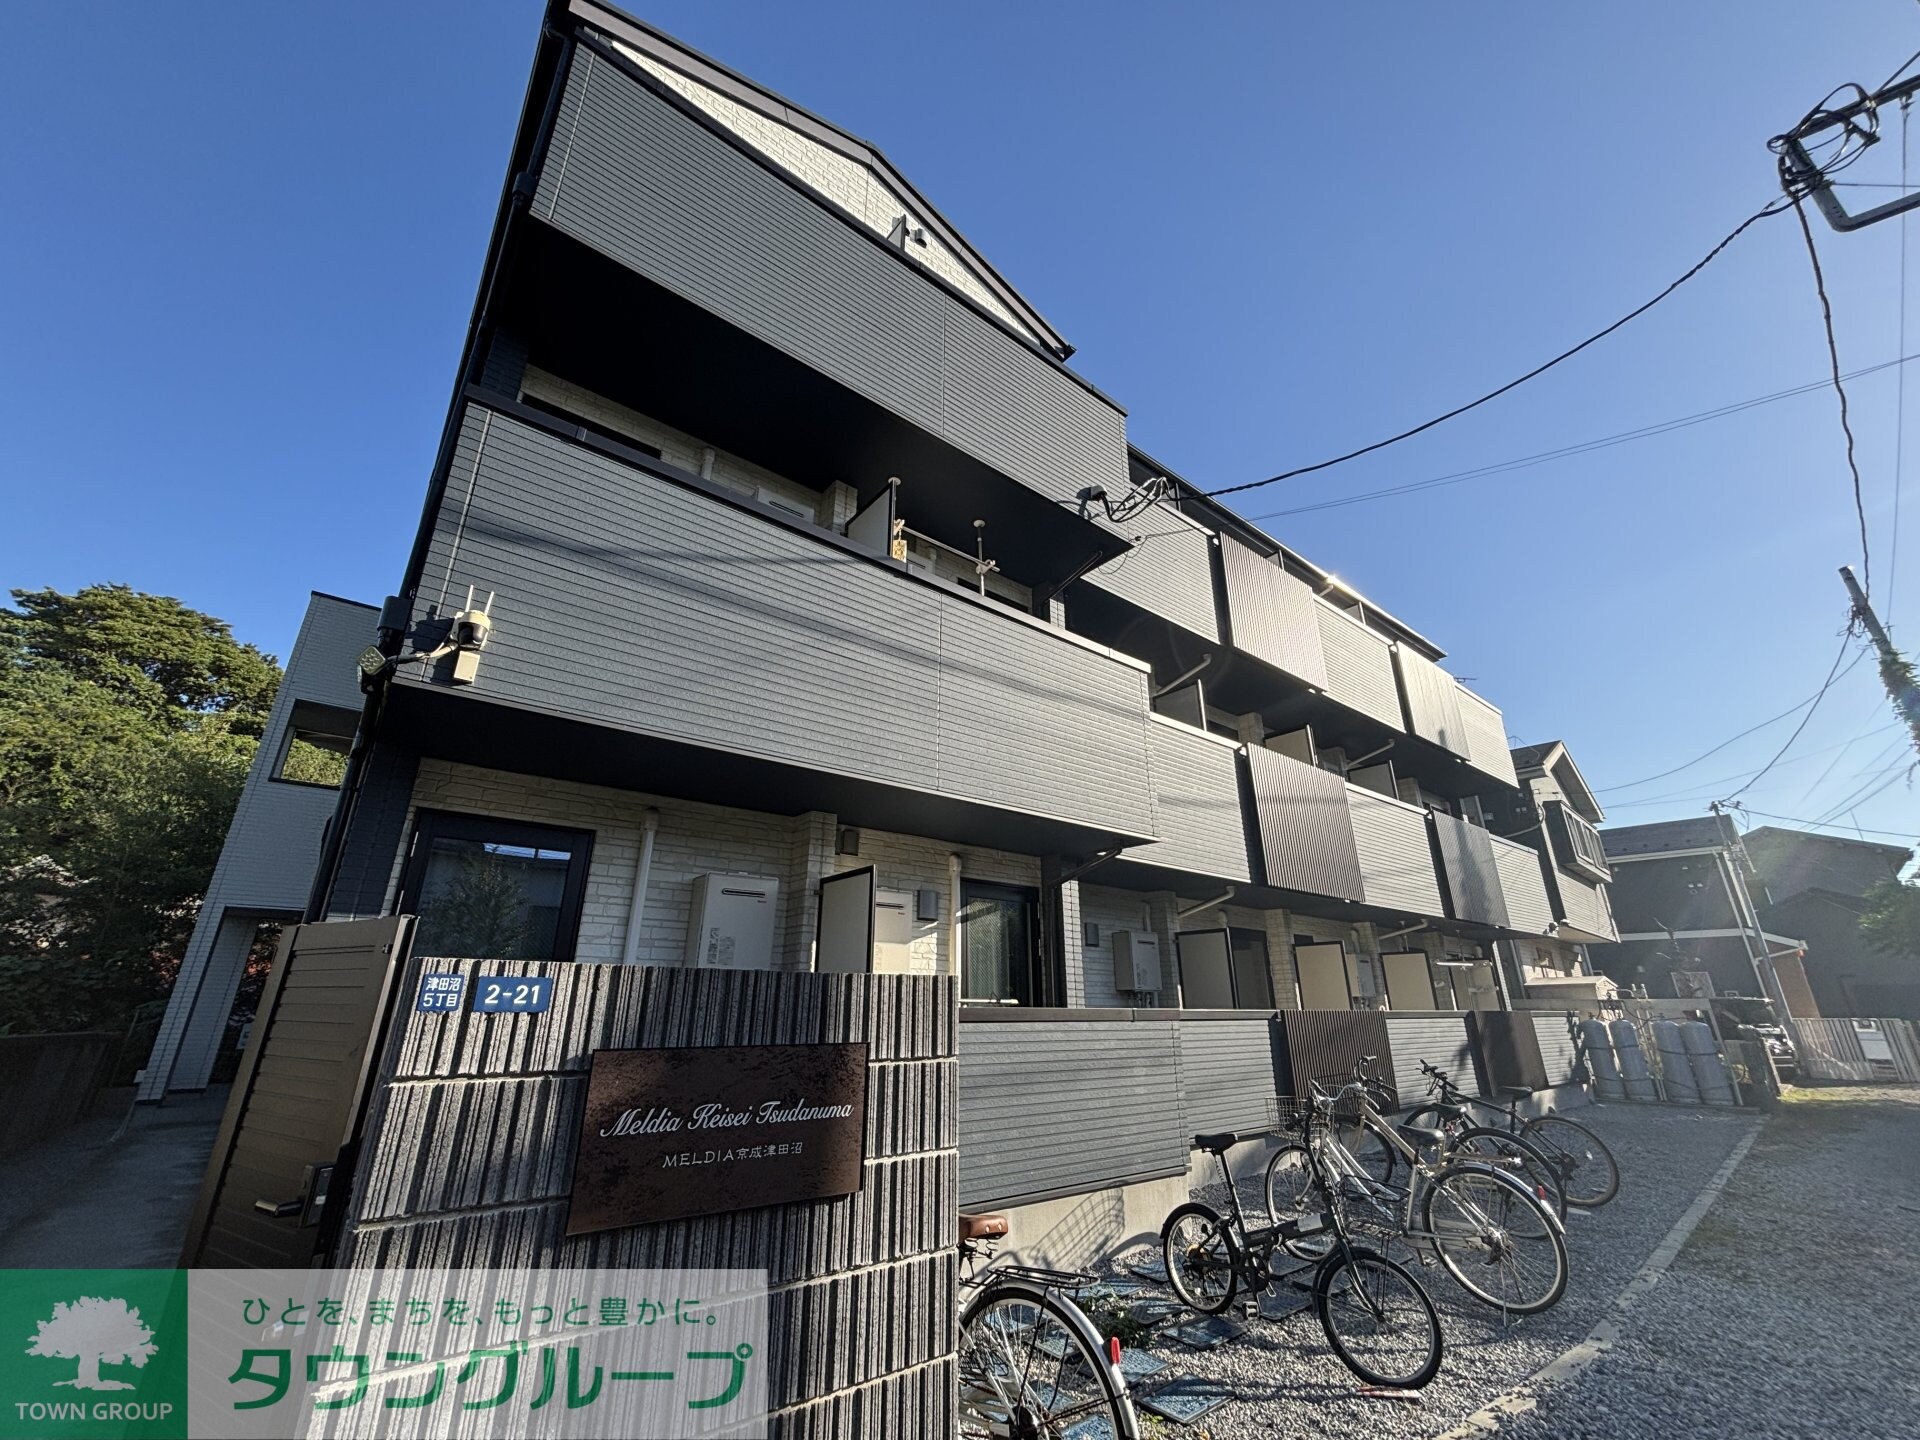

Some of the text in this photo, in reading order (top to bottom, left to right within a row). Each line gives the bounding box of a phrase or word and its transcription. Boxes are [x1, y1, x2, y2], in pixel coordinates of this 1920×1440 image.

[425, 977, 462, 991] 津田沼
[484, 984, 540, 1004] 2-21
[422, 993, 458, 1007] 5丁目
[600, 1098, 854, 1137] Meldia Keisei Tsudanuma
[662, 1142, 804, 1169] MELDIA京成津田沼
